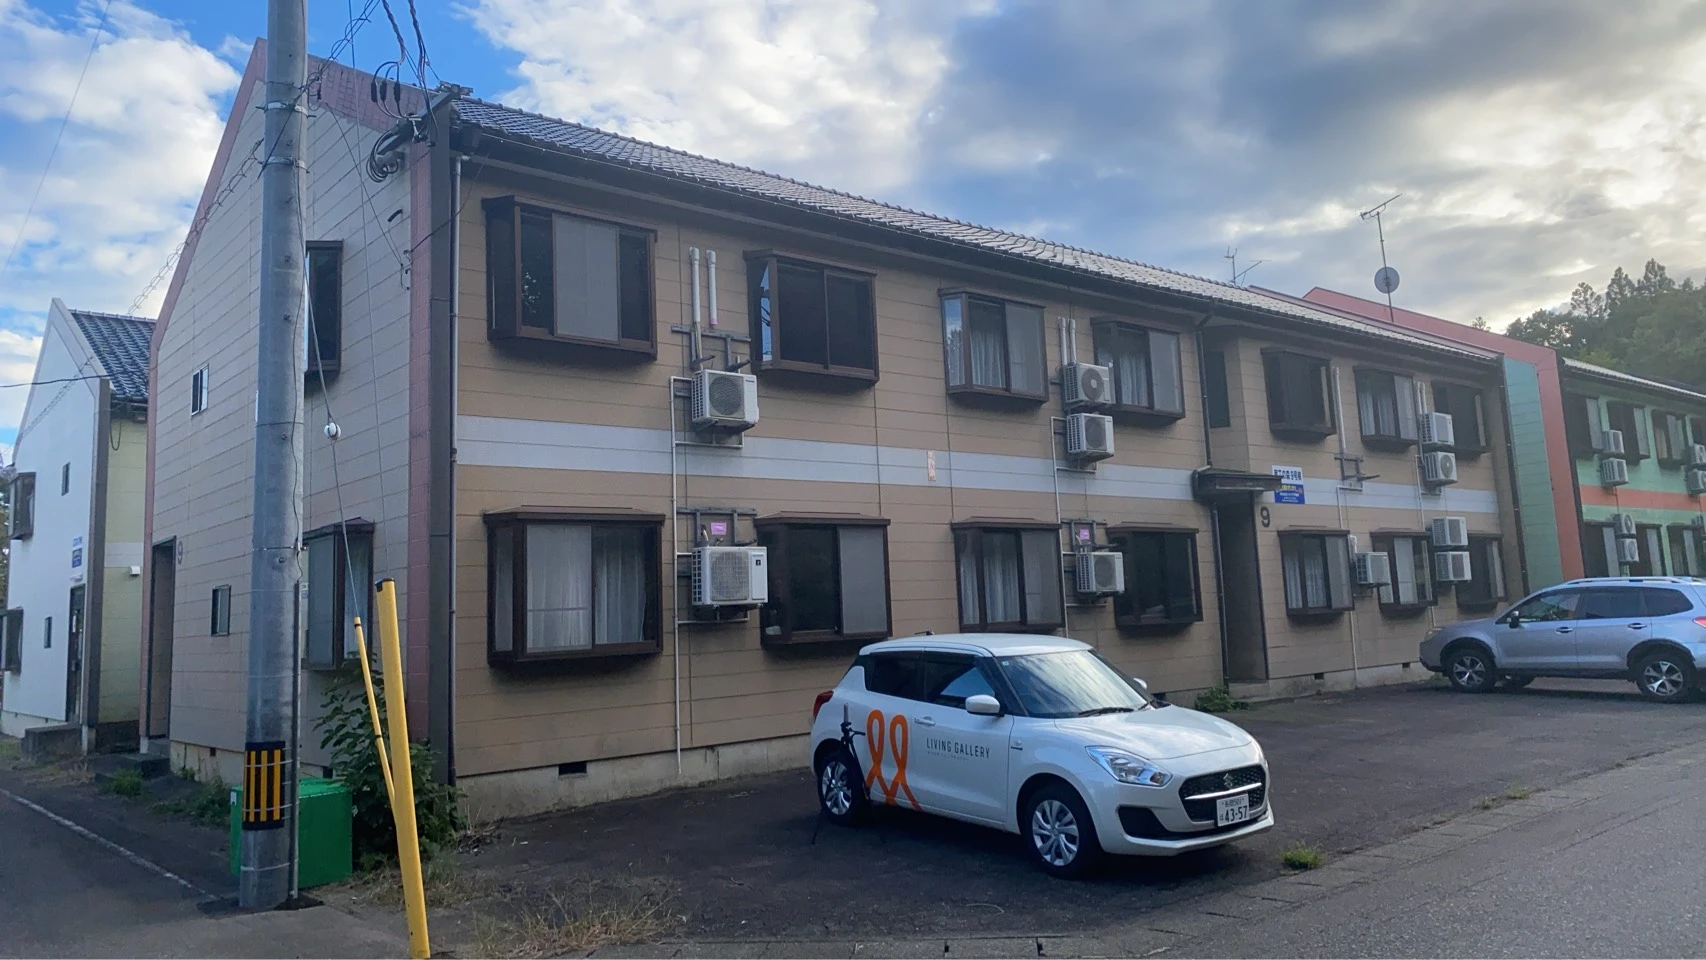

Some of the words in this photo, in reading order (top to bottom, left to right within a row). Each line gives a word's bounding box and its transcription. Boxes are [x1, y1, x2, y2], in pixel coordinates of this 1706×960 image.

[1260, 506, 1271, 528] 9
[177, 539, 184, 565] 9
[926, 737, 952, 752] LIVING
[954, 742, 990, 758] GALLERY
[1225, 805, 1247, 822] 43-57
